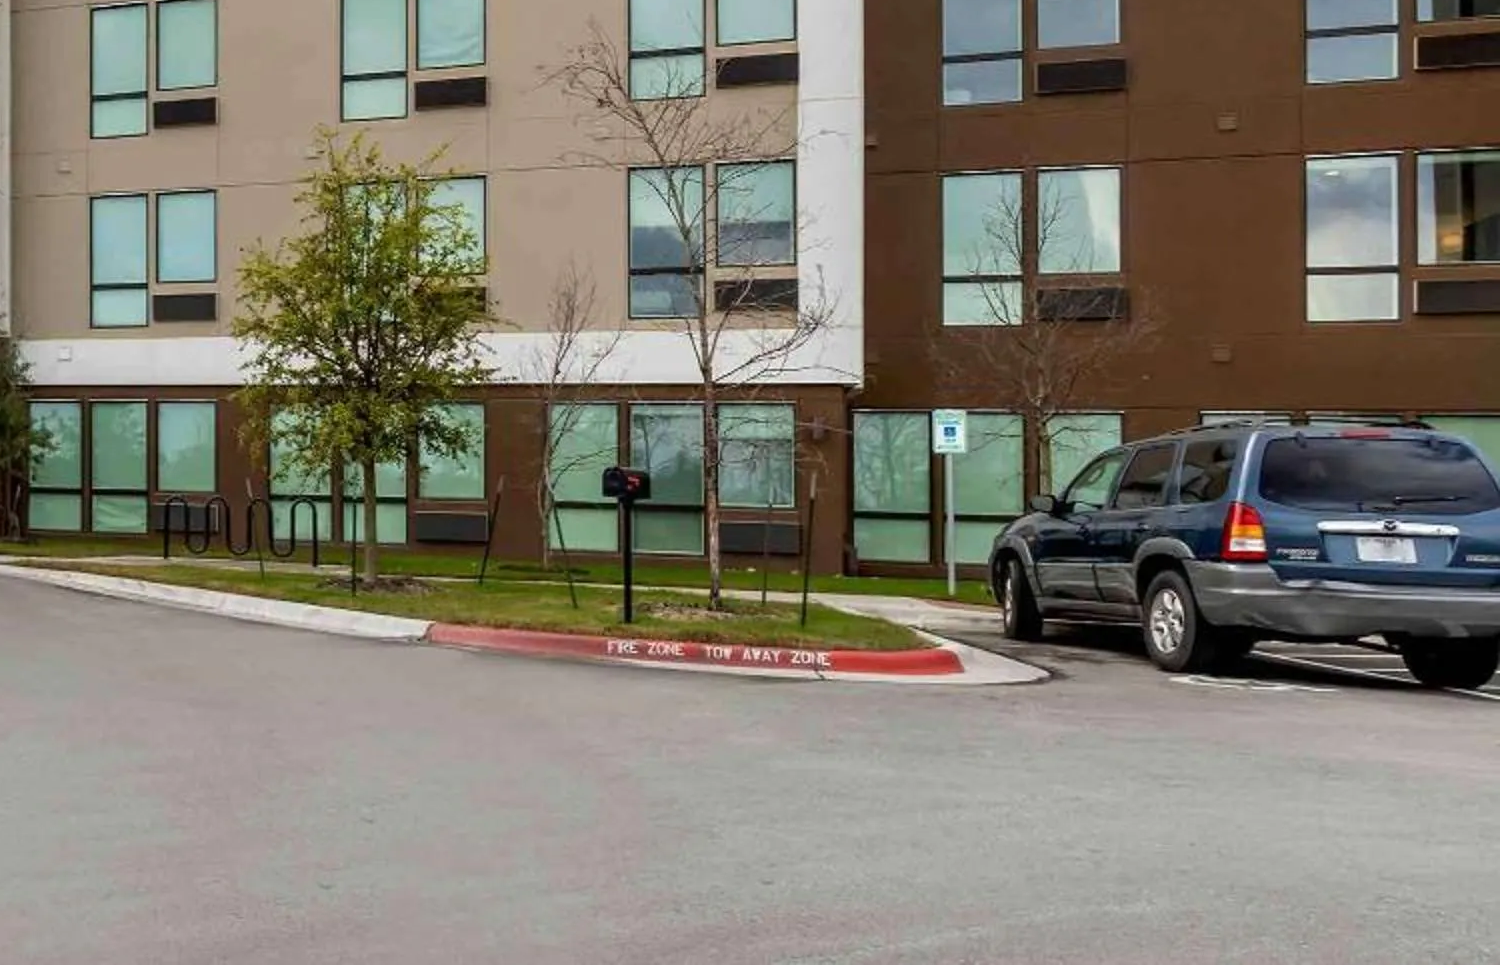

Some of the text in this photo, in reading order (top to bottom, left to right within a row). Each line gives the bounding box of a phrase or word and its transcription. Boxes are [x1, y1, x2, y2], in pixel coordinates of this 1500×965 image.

[607, 639, 831, 666] FIRE ZONE TOW AWAY ZONE
